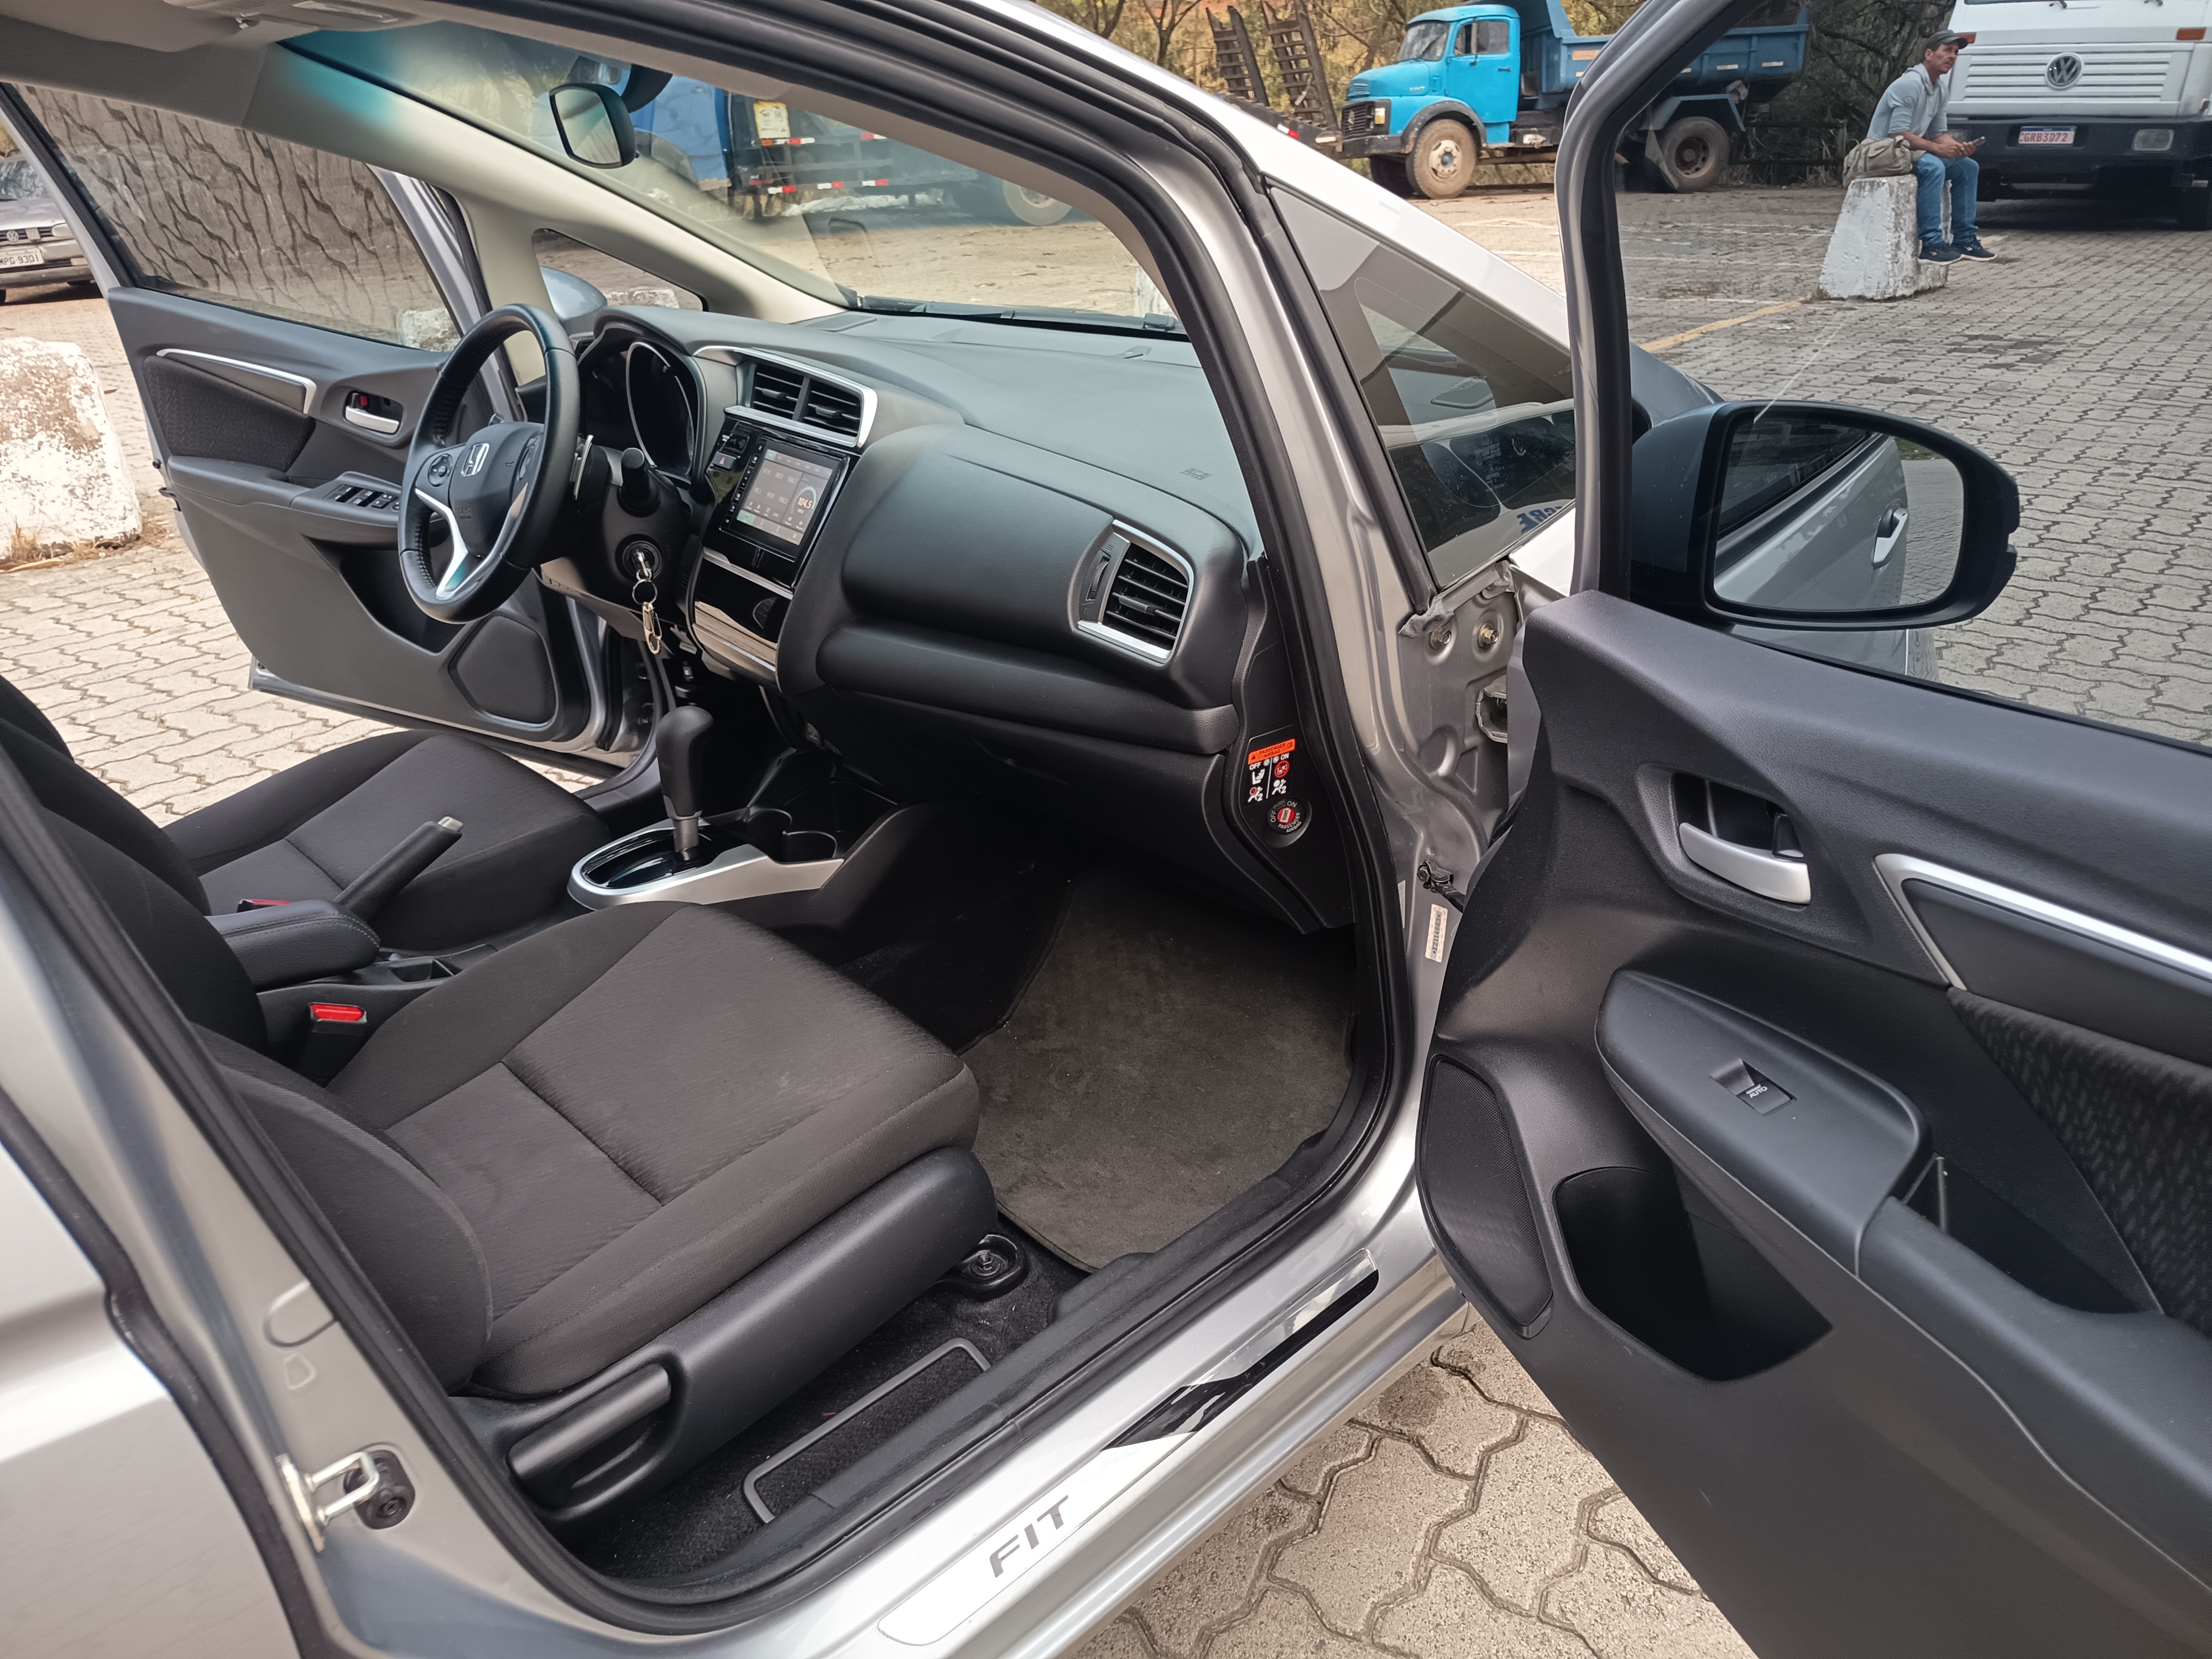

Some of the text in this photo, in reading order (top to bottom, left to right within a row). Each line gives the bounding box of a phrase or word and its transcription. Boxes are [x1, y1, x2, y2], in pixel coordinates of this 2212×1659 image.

[2023, 133, 2068, 142] GRB3D72
[797, 497, 813, 509] 104.5
[1259, 743, 1286, 755] PASSENGER
[1264, 749, 1281, 758] AIRBAG
[1249, 761, 1261, 770] OFF
[1277, 812, 1301, 829] PASSENGER
[1286, 821, 1302, 833] AIRBAG
[1749, 1086, 1768, 1098] AUTO
[989, 1494, 1068, 1578] FIT
